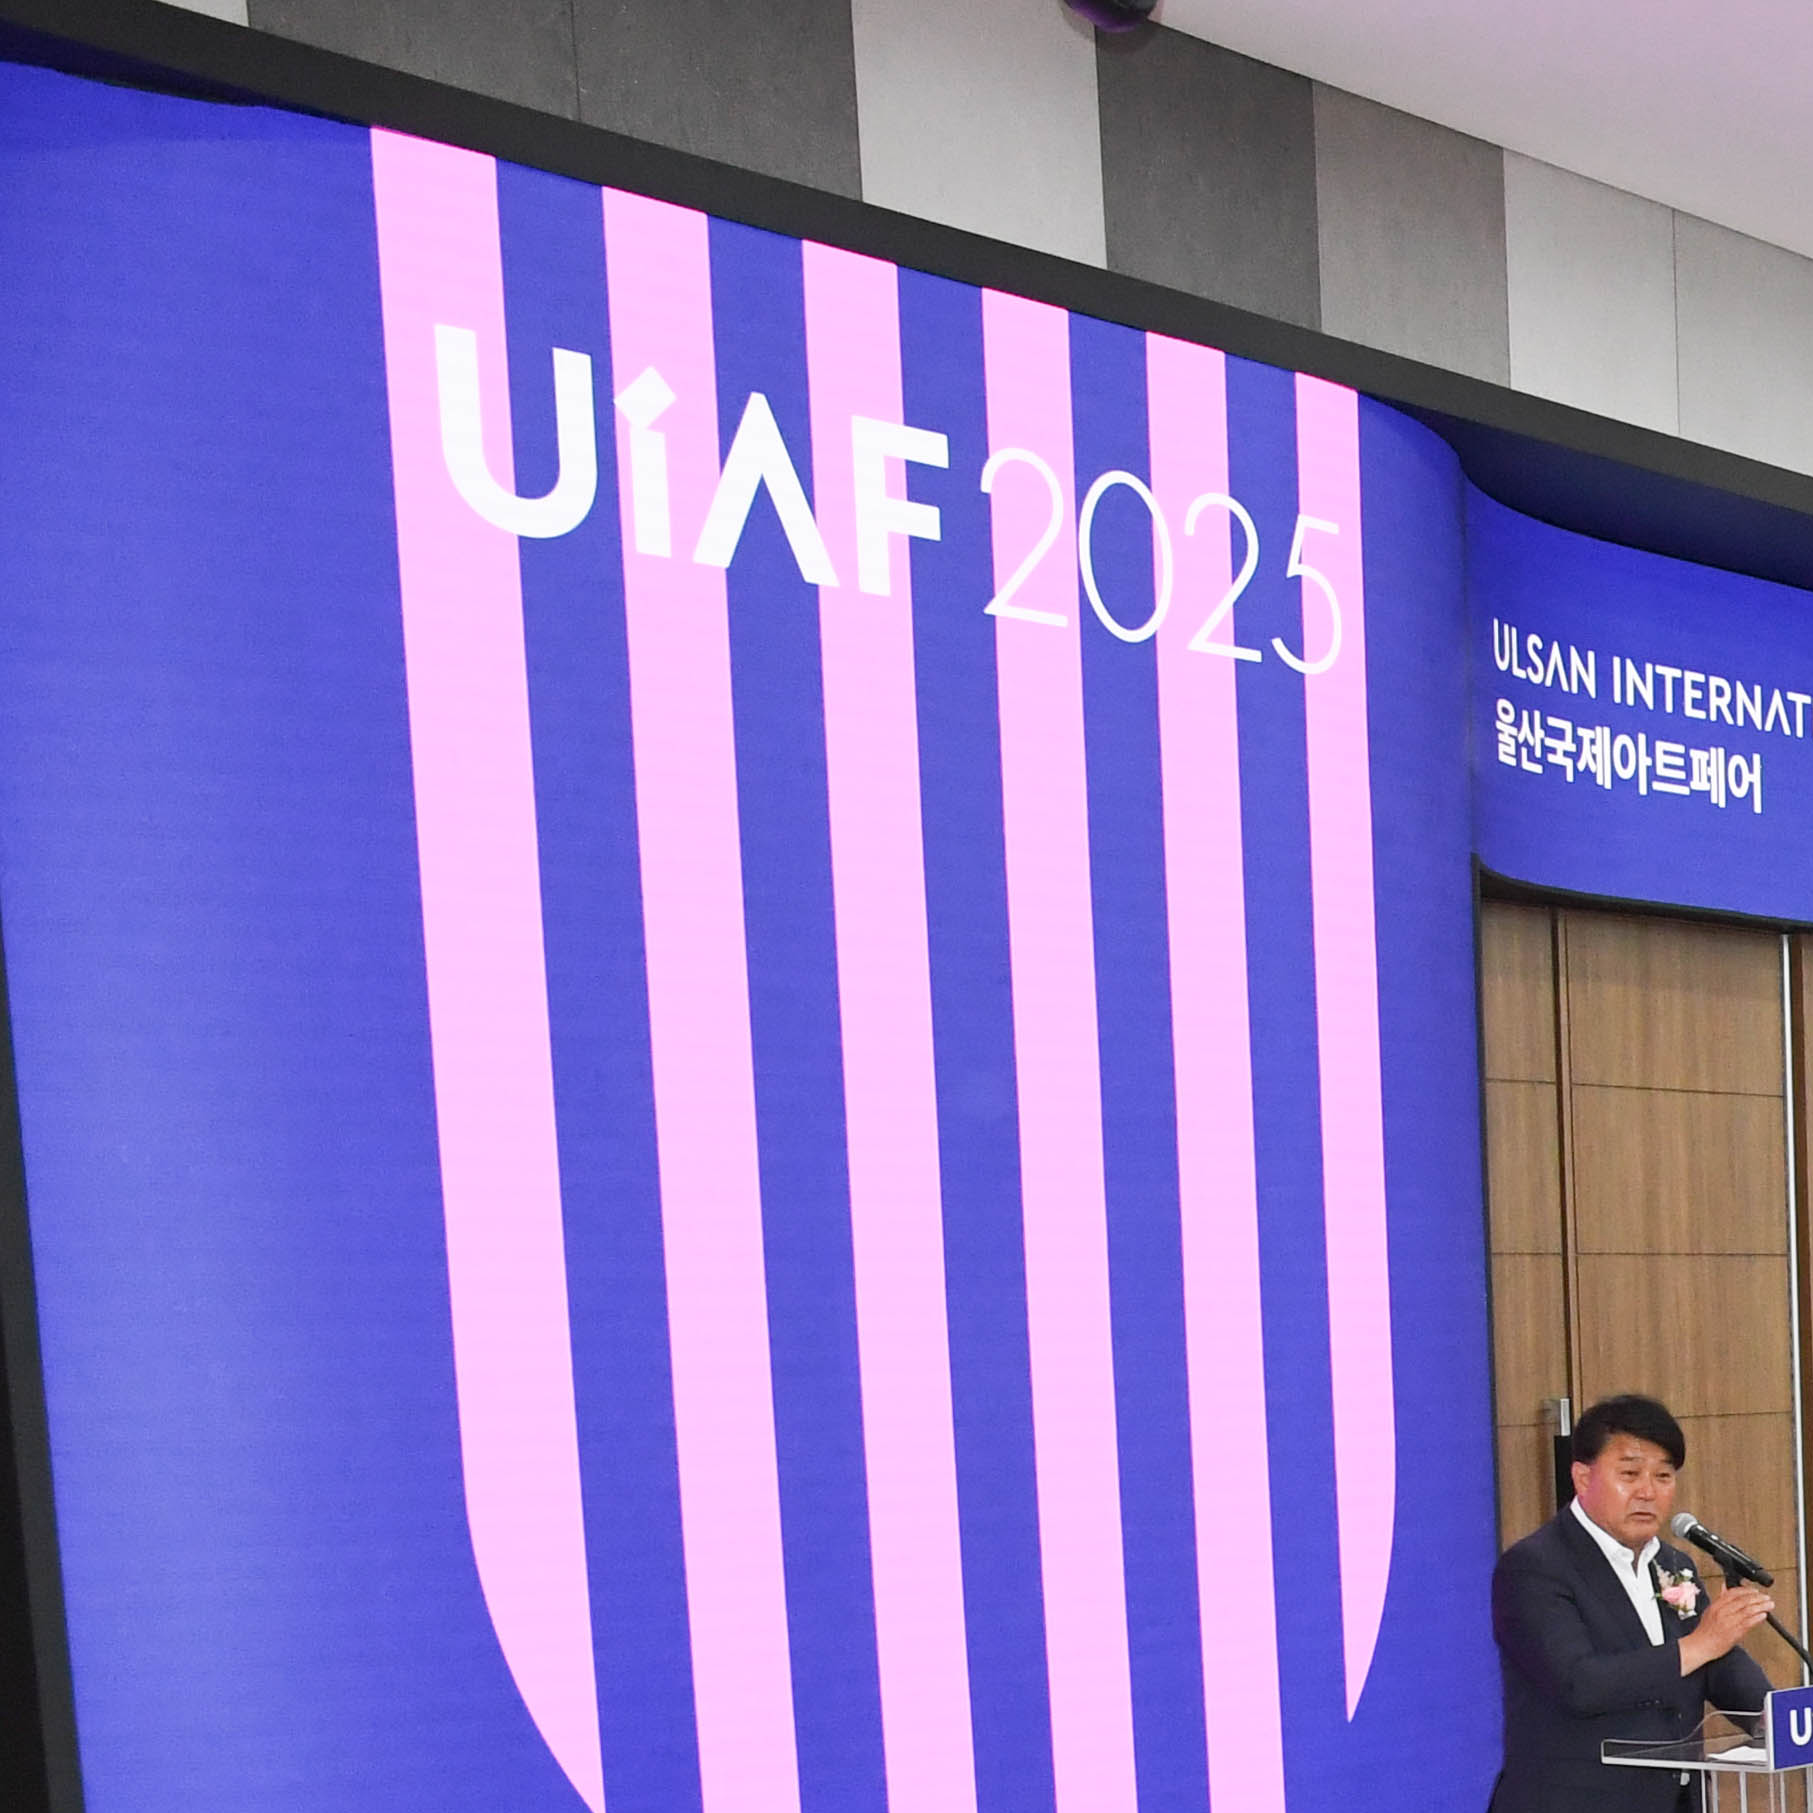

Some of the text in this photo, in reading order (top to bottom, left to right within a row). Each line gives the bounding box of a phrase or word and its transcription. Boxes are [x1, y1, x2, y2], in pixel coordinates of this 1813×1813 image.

[980, 447, 1342, 675] 2025
[1493, 618, 1596, 699] ULSAN
[1495, 698, 1762, 814] 울산국제아트페어
